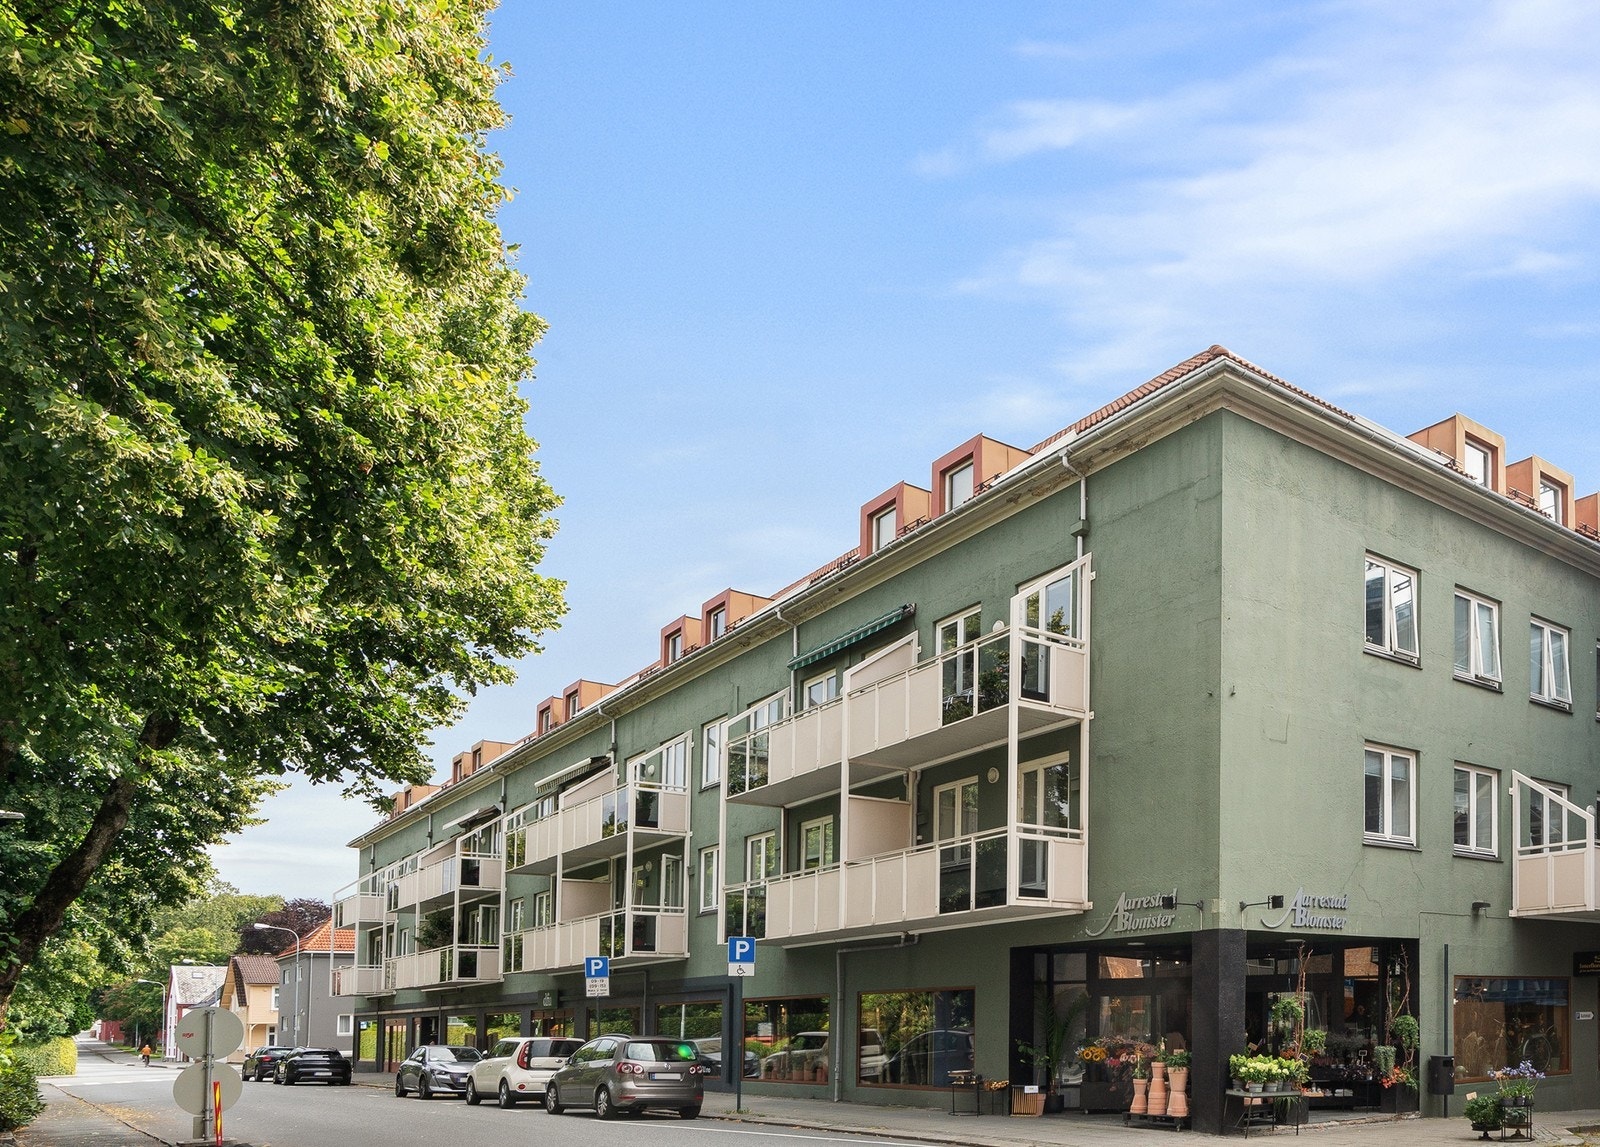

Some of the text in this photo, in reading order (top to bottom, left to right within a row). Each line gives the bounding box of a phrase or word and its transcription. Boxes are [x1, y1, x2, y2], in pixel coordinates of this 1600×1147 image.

[1114, 911, 1175, 932] Blomster
[1291, 907, 1347, 930] Blomster
[735, 940, 750, 960] P
[591, 959, 603, 976] P
